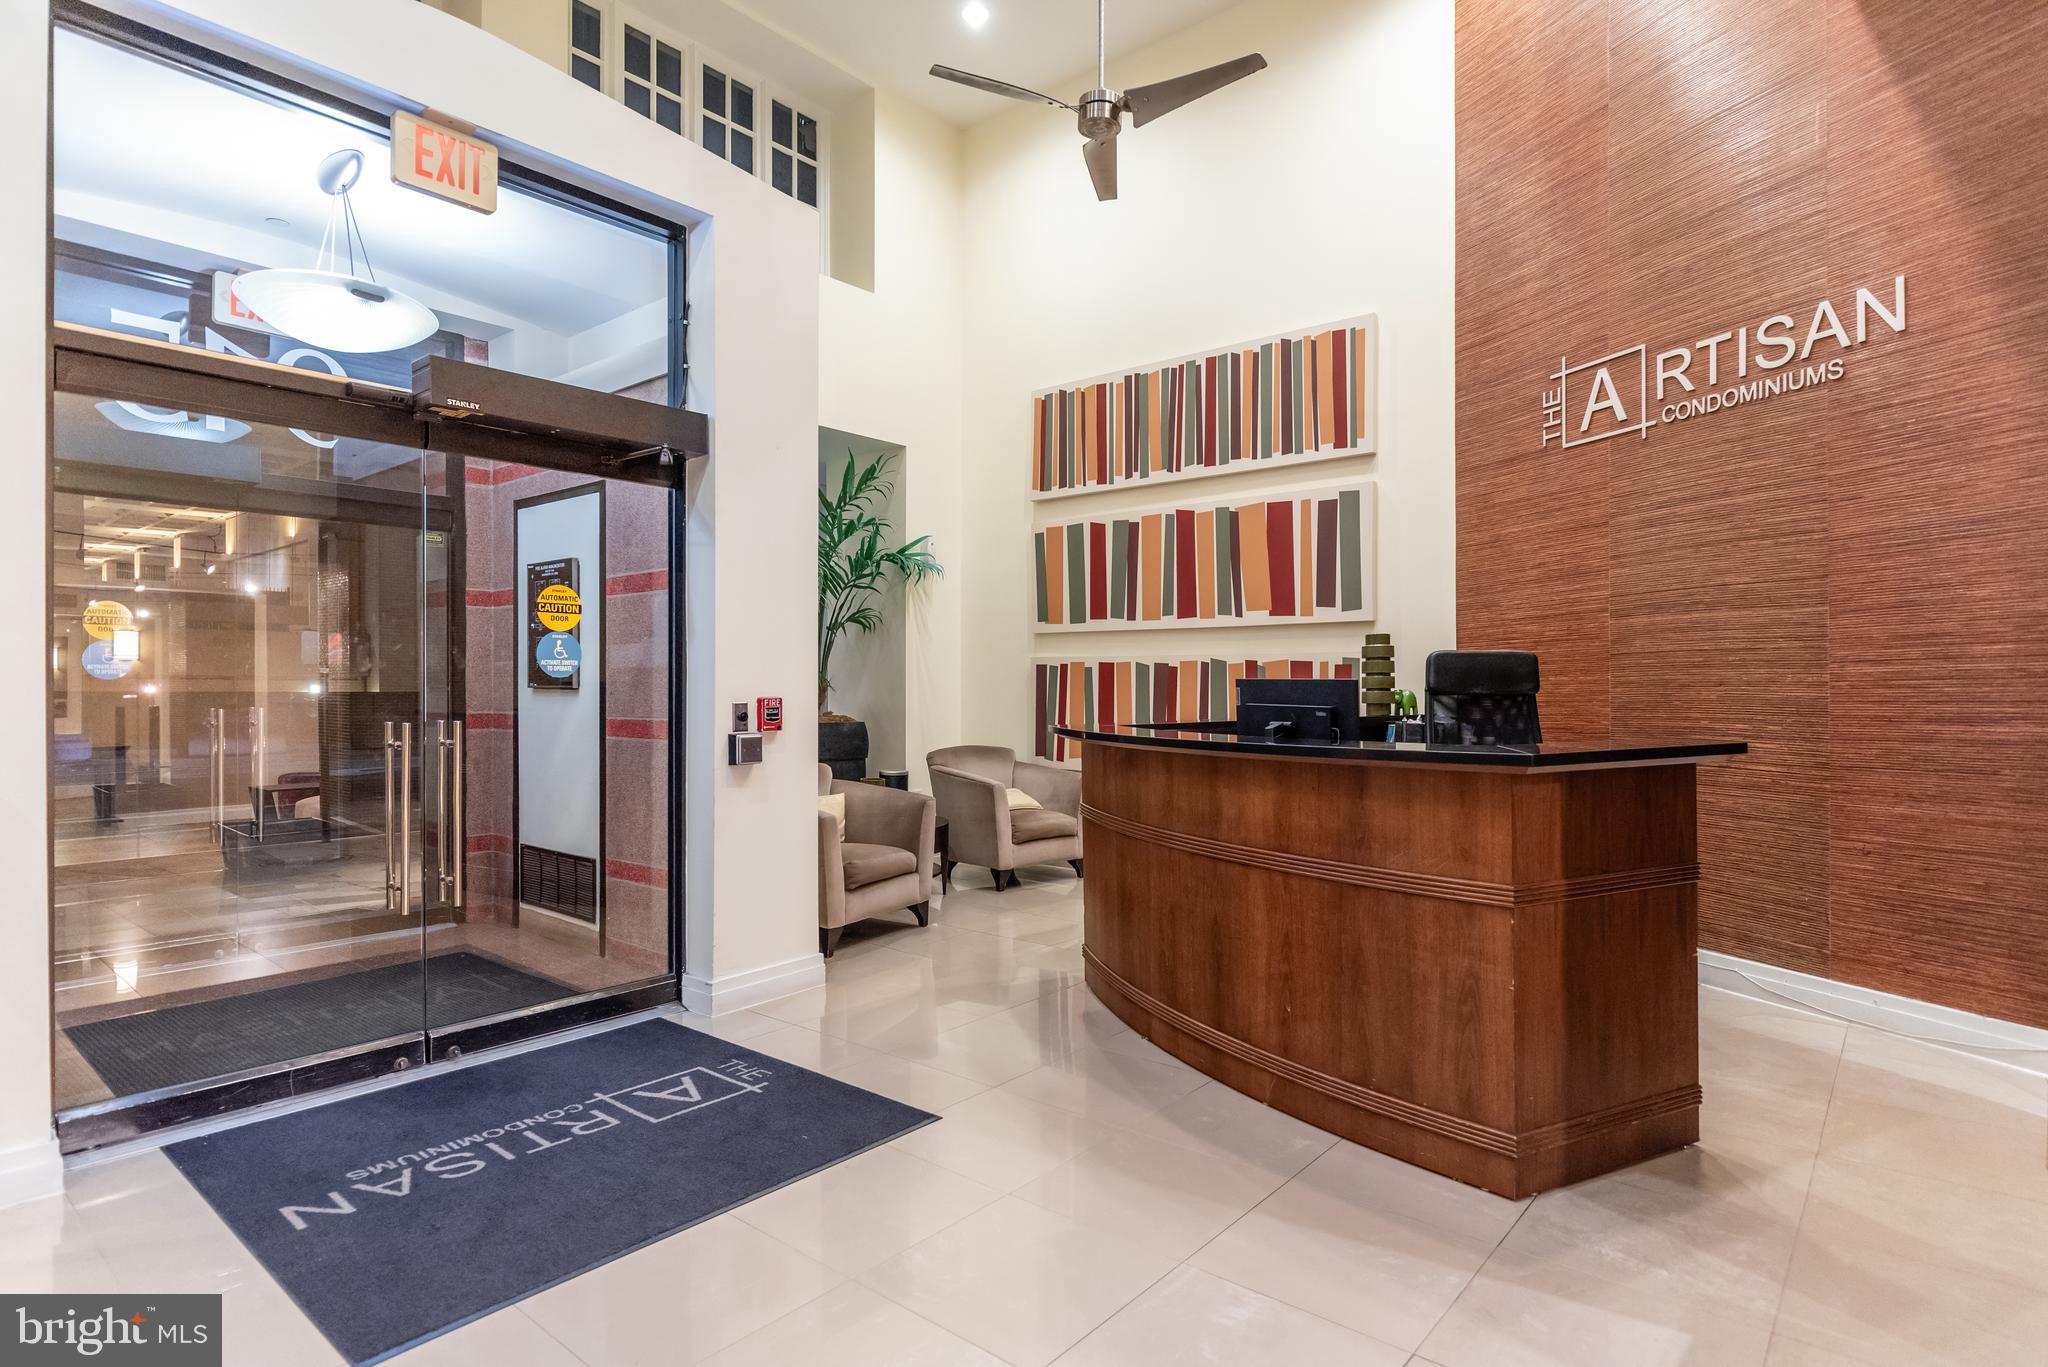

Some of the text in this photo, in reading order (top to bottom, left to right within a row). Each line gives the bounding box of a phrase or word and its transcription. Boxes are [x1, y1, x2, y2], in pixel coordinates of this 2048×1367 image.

[415, 124, 485, 196] EXIT
[1661, 358, 1845, 423] CONDOMINIUMS
[447, 398, 480, 410] STANLEY
[1542, 385, 1562, 447] THE
[540, 594, 579, 603] AUTOMATIC
[538, 603, 580, 614] CAUTION
[84, 616, 130, 625] CAUTION
[764, 699, 780, 707] FIRE
[717, 1058, 773, 1083] THE
[345, 1102, 585, 1182] CONDOMINIUMS
